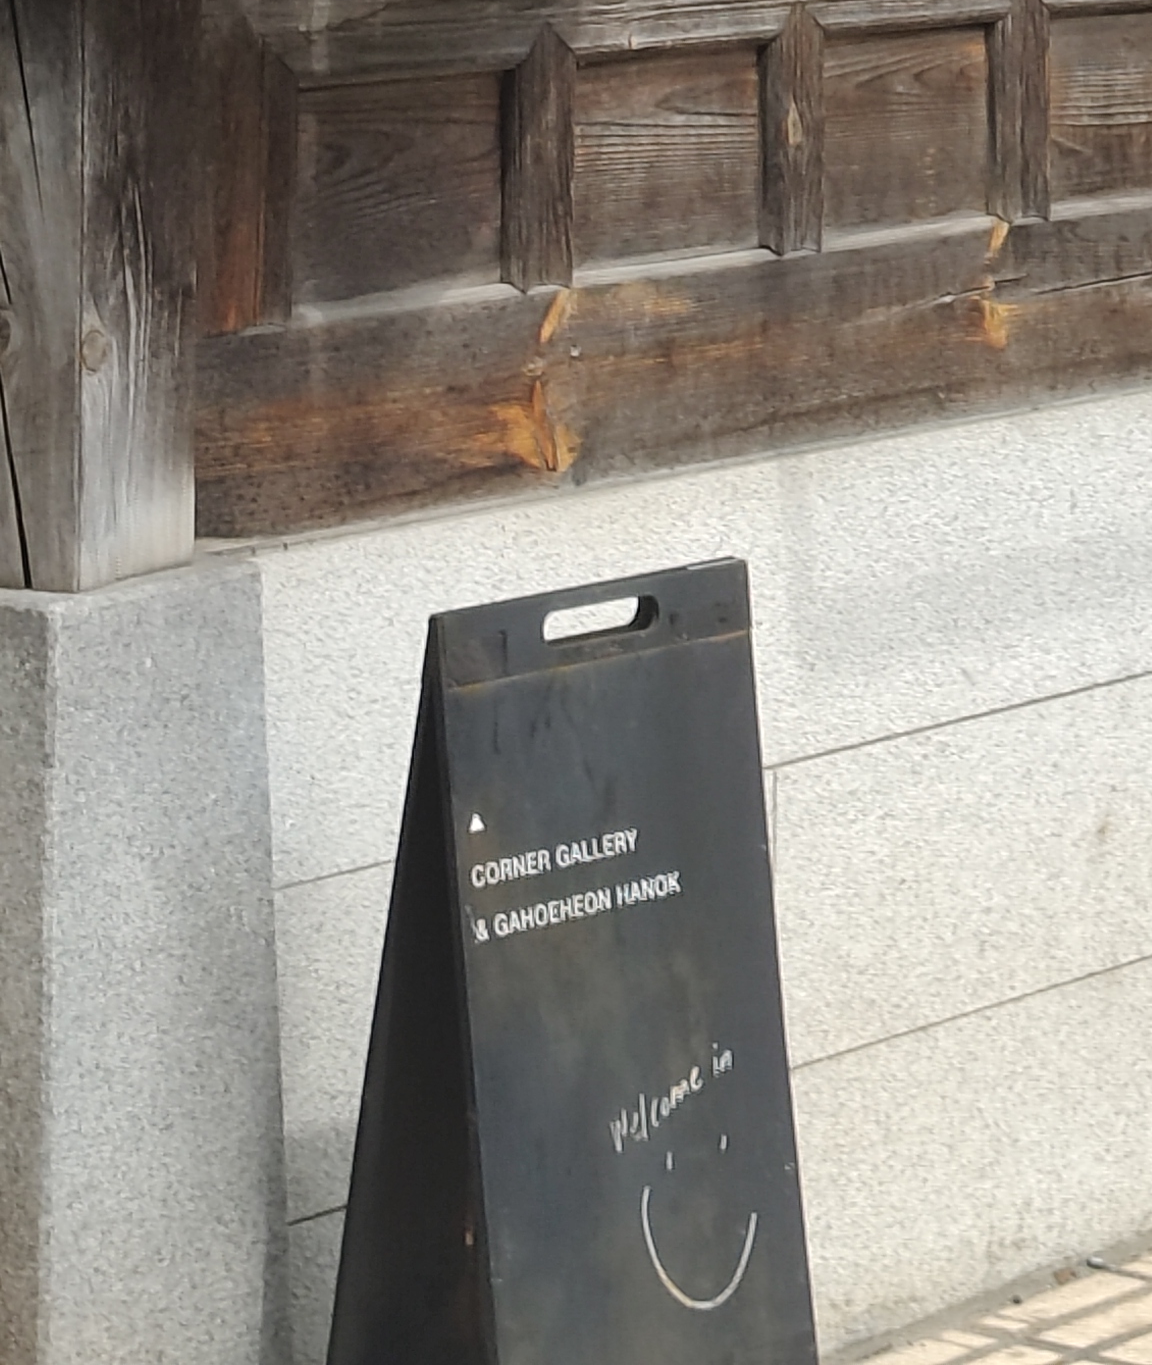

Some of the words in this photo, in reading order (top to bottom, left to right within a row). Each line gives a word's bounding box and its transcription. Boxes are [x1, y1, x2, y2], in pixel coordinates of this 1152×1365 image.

[471, 850, 552, 888] CORNER
[556, 828, 638, 867] GALLERY
[475, 918, 490, 943] &
[616, 871, 682, 906] HANOK
[712, 1042, 734, 1078] in
